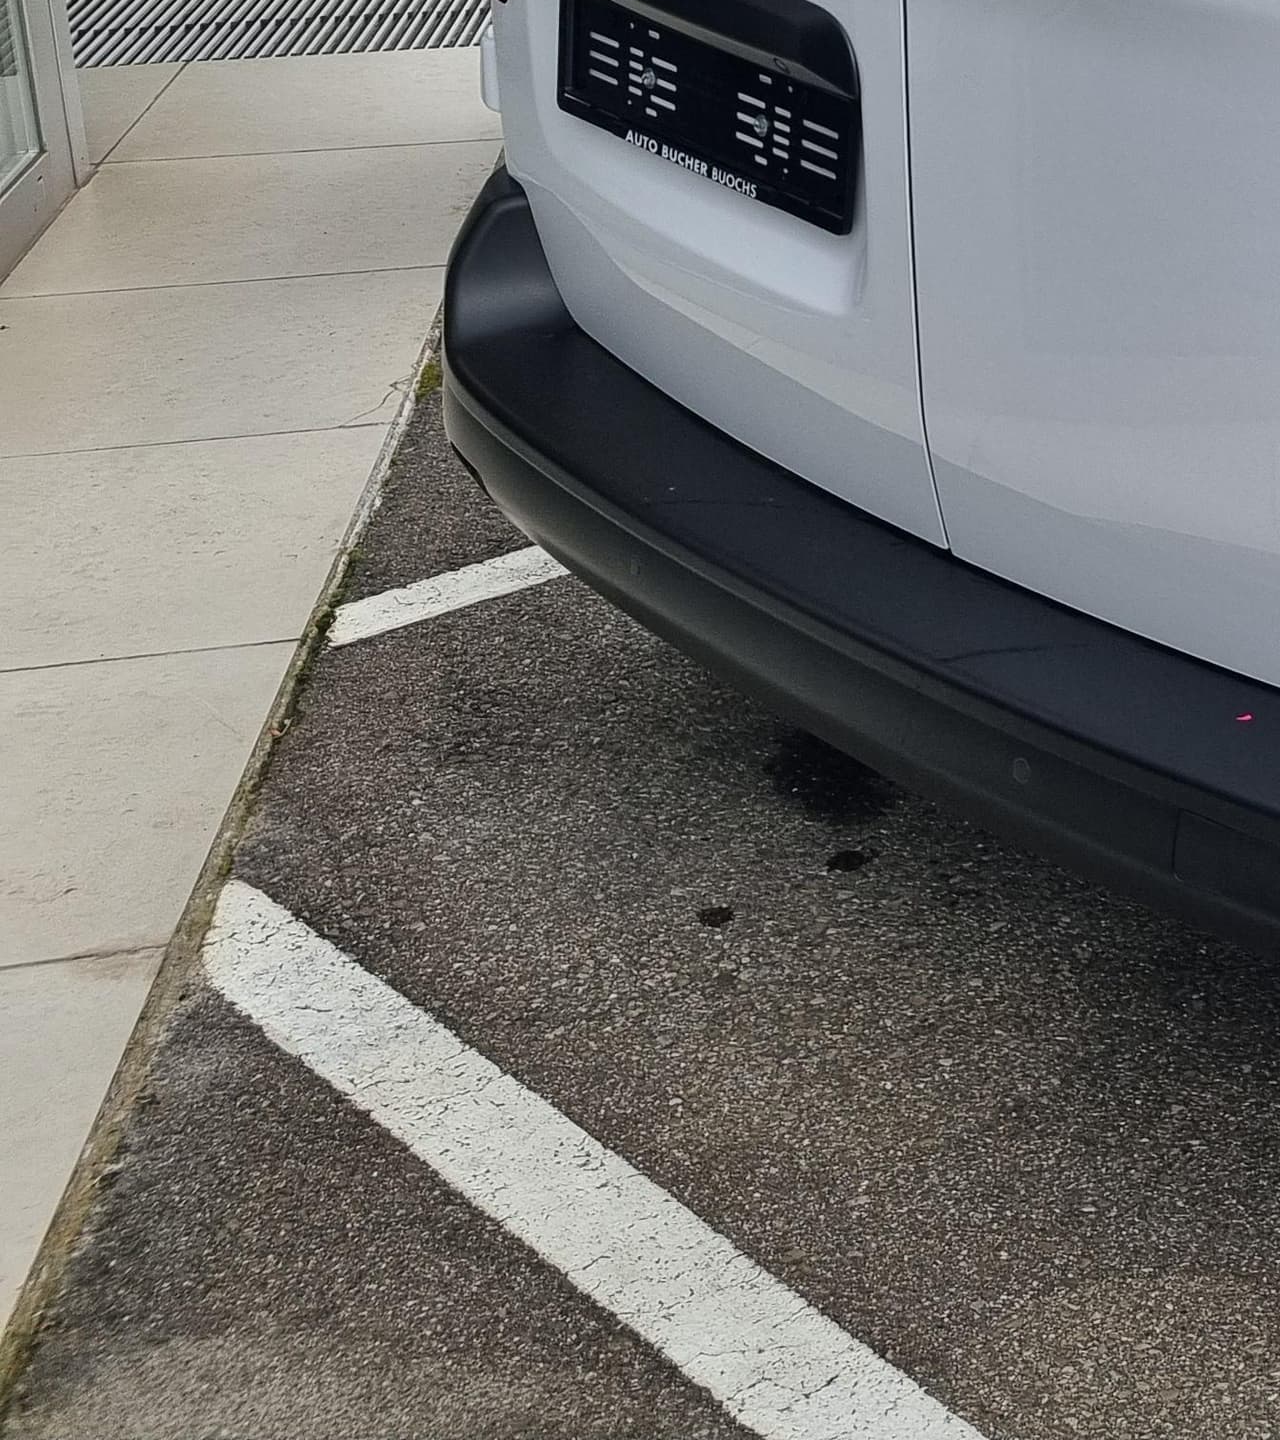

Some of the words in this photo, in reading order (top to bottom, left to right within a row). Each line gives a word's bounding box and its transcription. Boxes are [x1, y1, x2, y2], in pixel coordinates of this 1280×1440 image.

[625, 129, 658, 153] AUTO
[661, 144, 708, 177] BUCHER
[711, 165, 758, 198] BUOCHS
